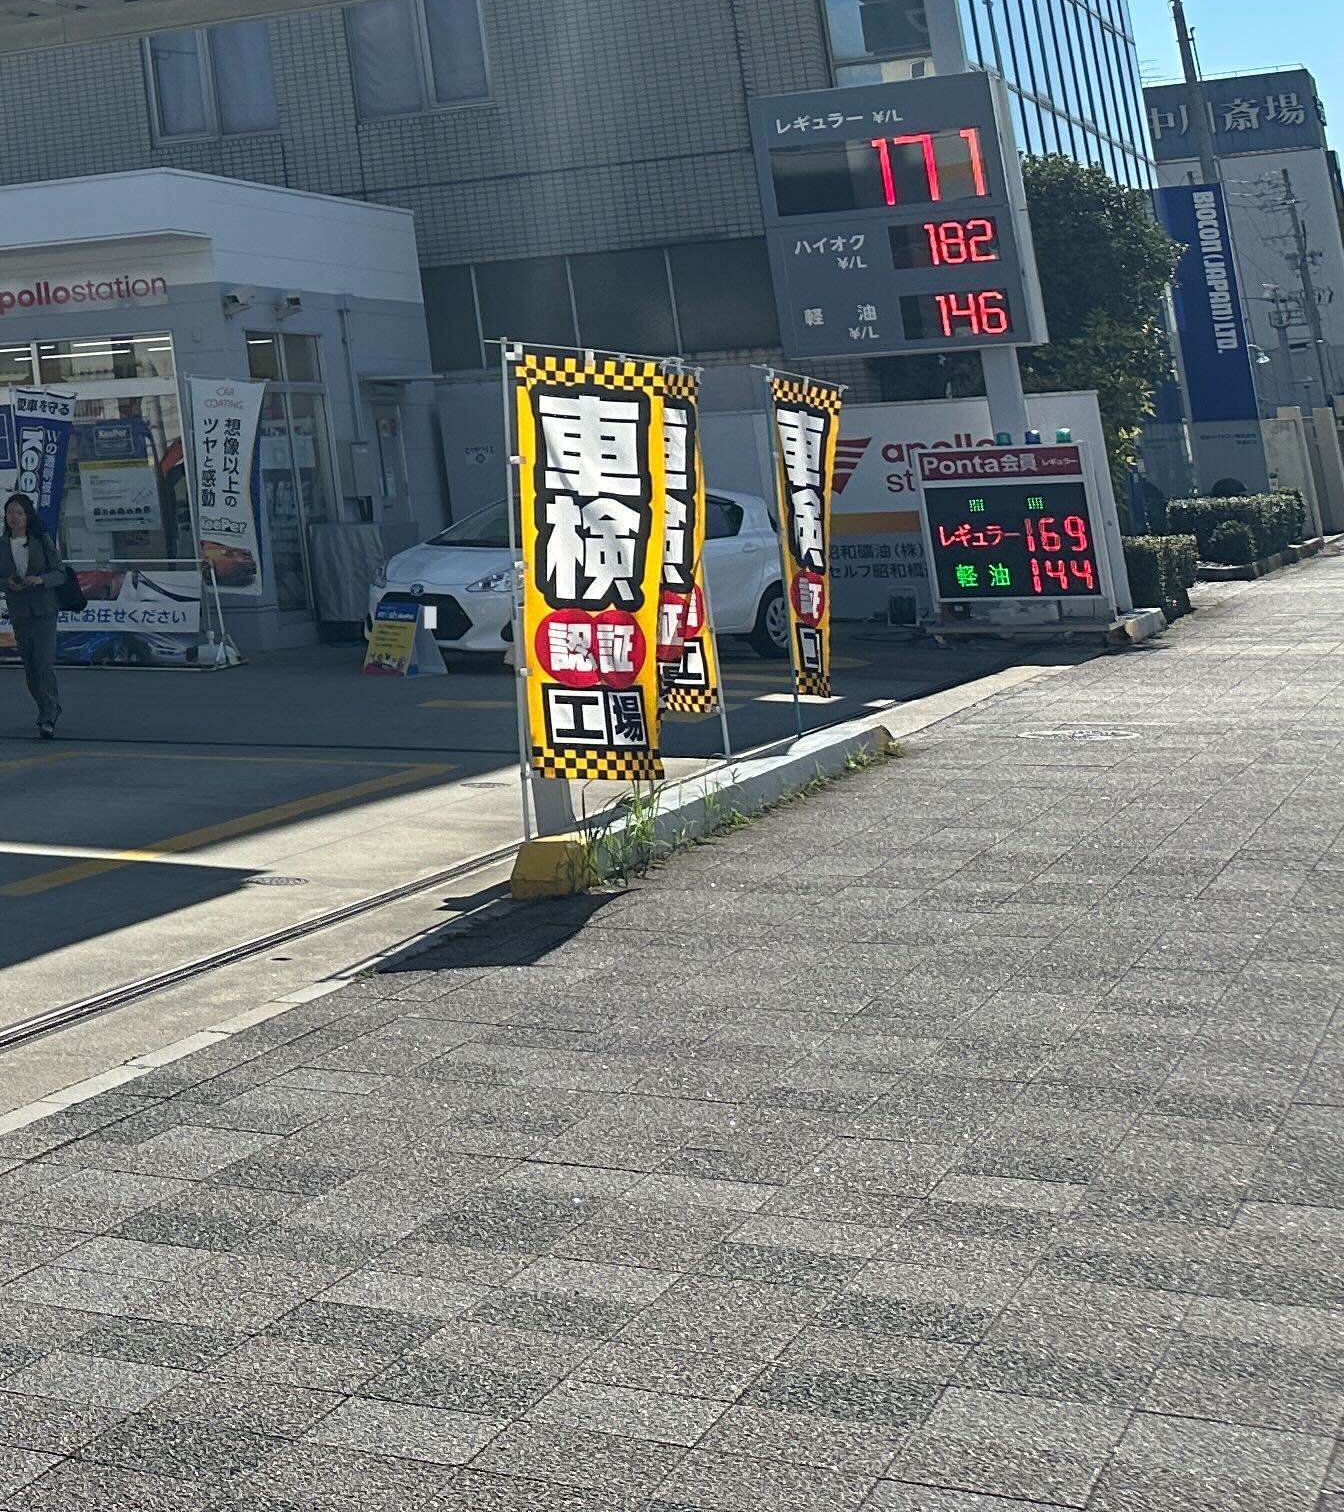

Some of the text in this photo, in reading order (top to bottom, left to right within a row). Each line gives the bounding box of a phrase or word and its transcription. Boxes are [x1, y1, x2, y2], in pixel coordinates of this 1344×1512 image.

[775, 109, 904, 135] レギュラー ¥/L
[871, 128, 988, 206] 171
[794, 234, 865, 255] ハイオク
[923, 219, 1000, 266] 182
[836, 255, 868, 270] ¥/L
[848, 326, 880, 340] ¥/L
[934, 291, 1009, 337] 146
[1214, 322, 1240, 355] LTD.
[17, 398, 70, 416] 愛車を守る
[201, 418, 219, 507] ツヤと感動
[222, 417, 241, 508] 想像以上の
[921, 454, 1038, 476] Ponta会員
[538, 394, 643, 601] 車検
[939, 515, 1089, 553] レギュラー 169
[955, 557, 1095, 594] 軽油 144
[546, 620, 635, 675] 認証
[551, 691, 645, 744] 工場
